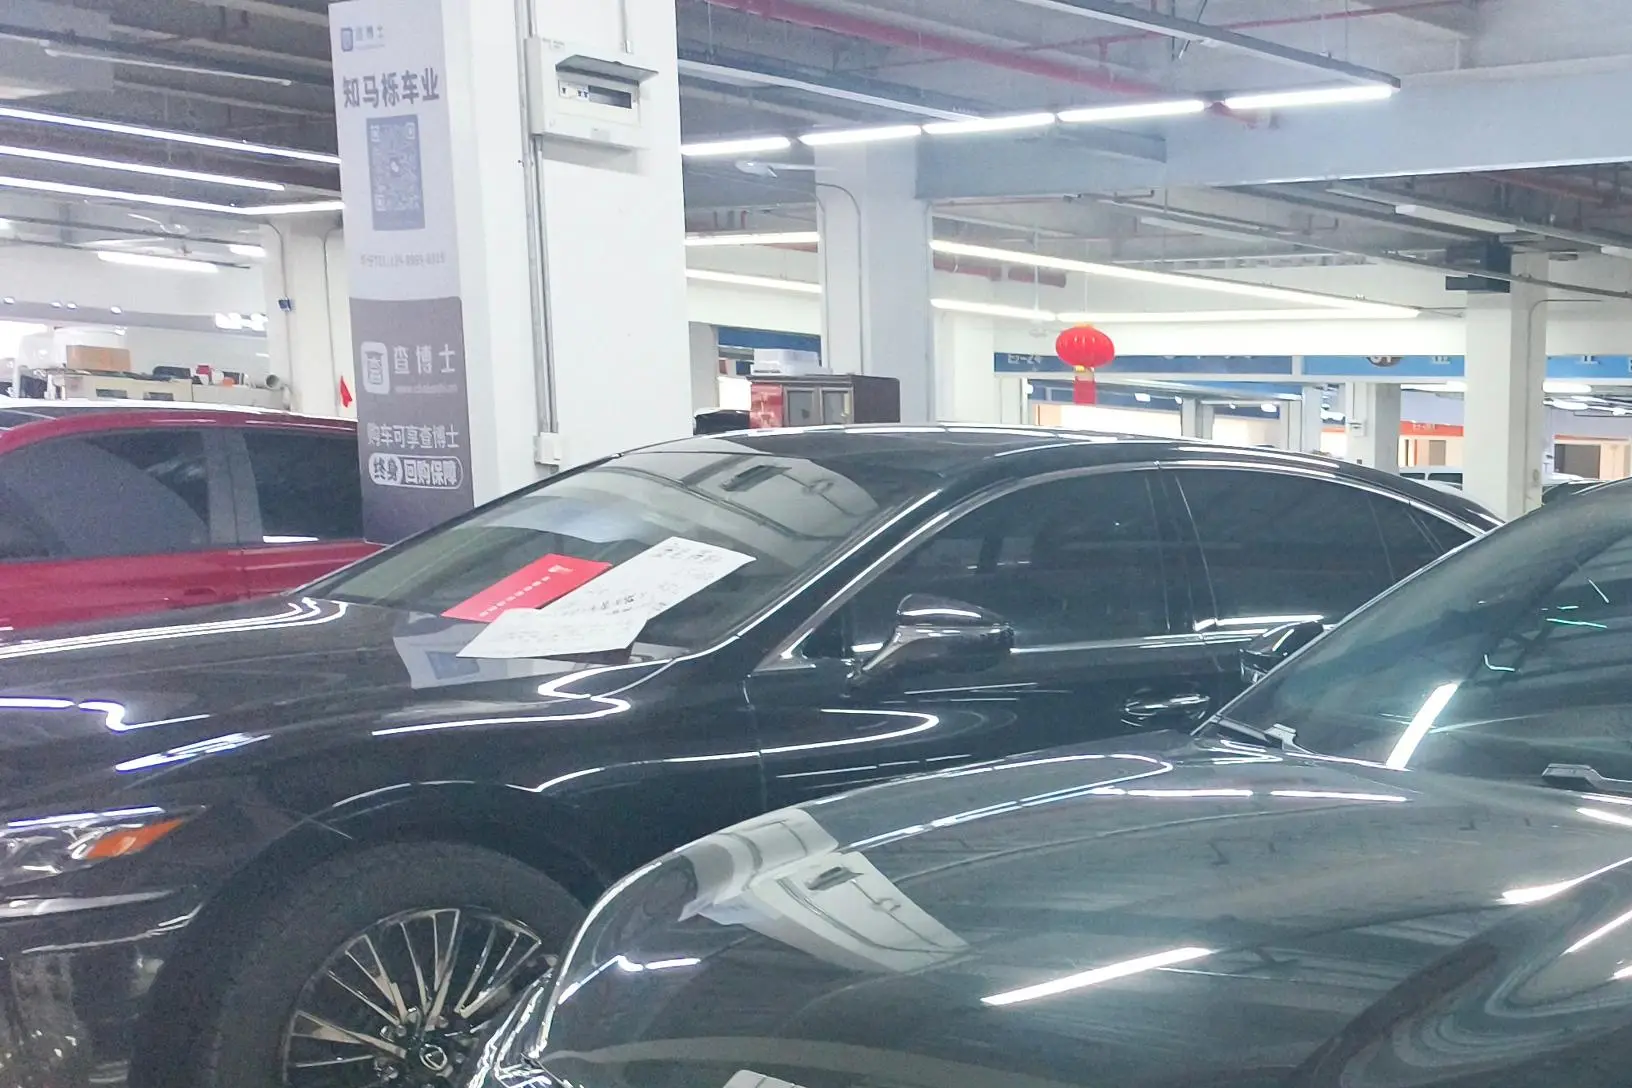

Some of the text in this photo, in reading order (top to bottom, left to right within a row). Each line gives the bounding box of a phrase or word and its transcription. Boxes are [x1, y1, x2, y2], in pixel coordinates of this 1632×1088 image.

[393, 343, 455, 375] 查博士
[367, 422, 459, 449] 购车可享查博士
